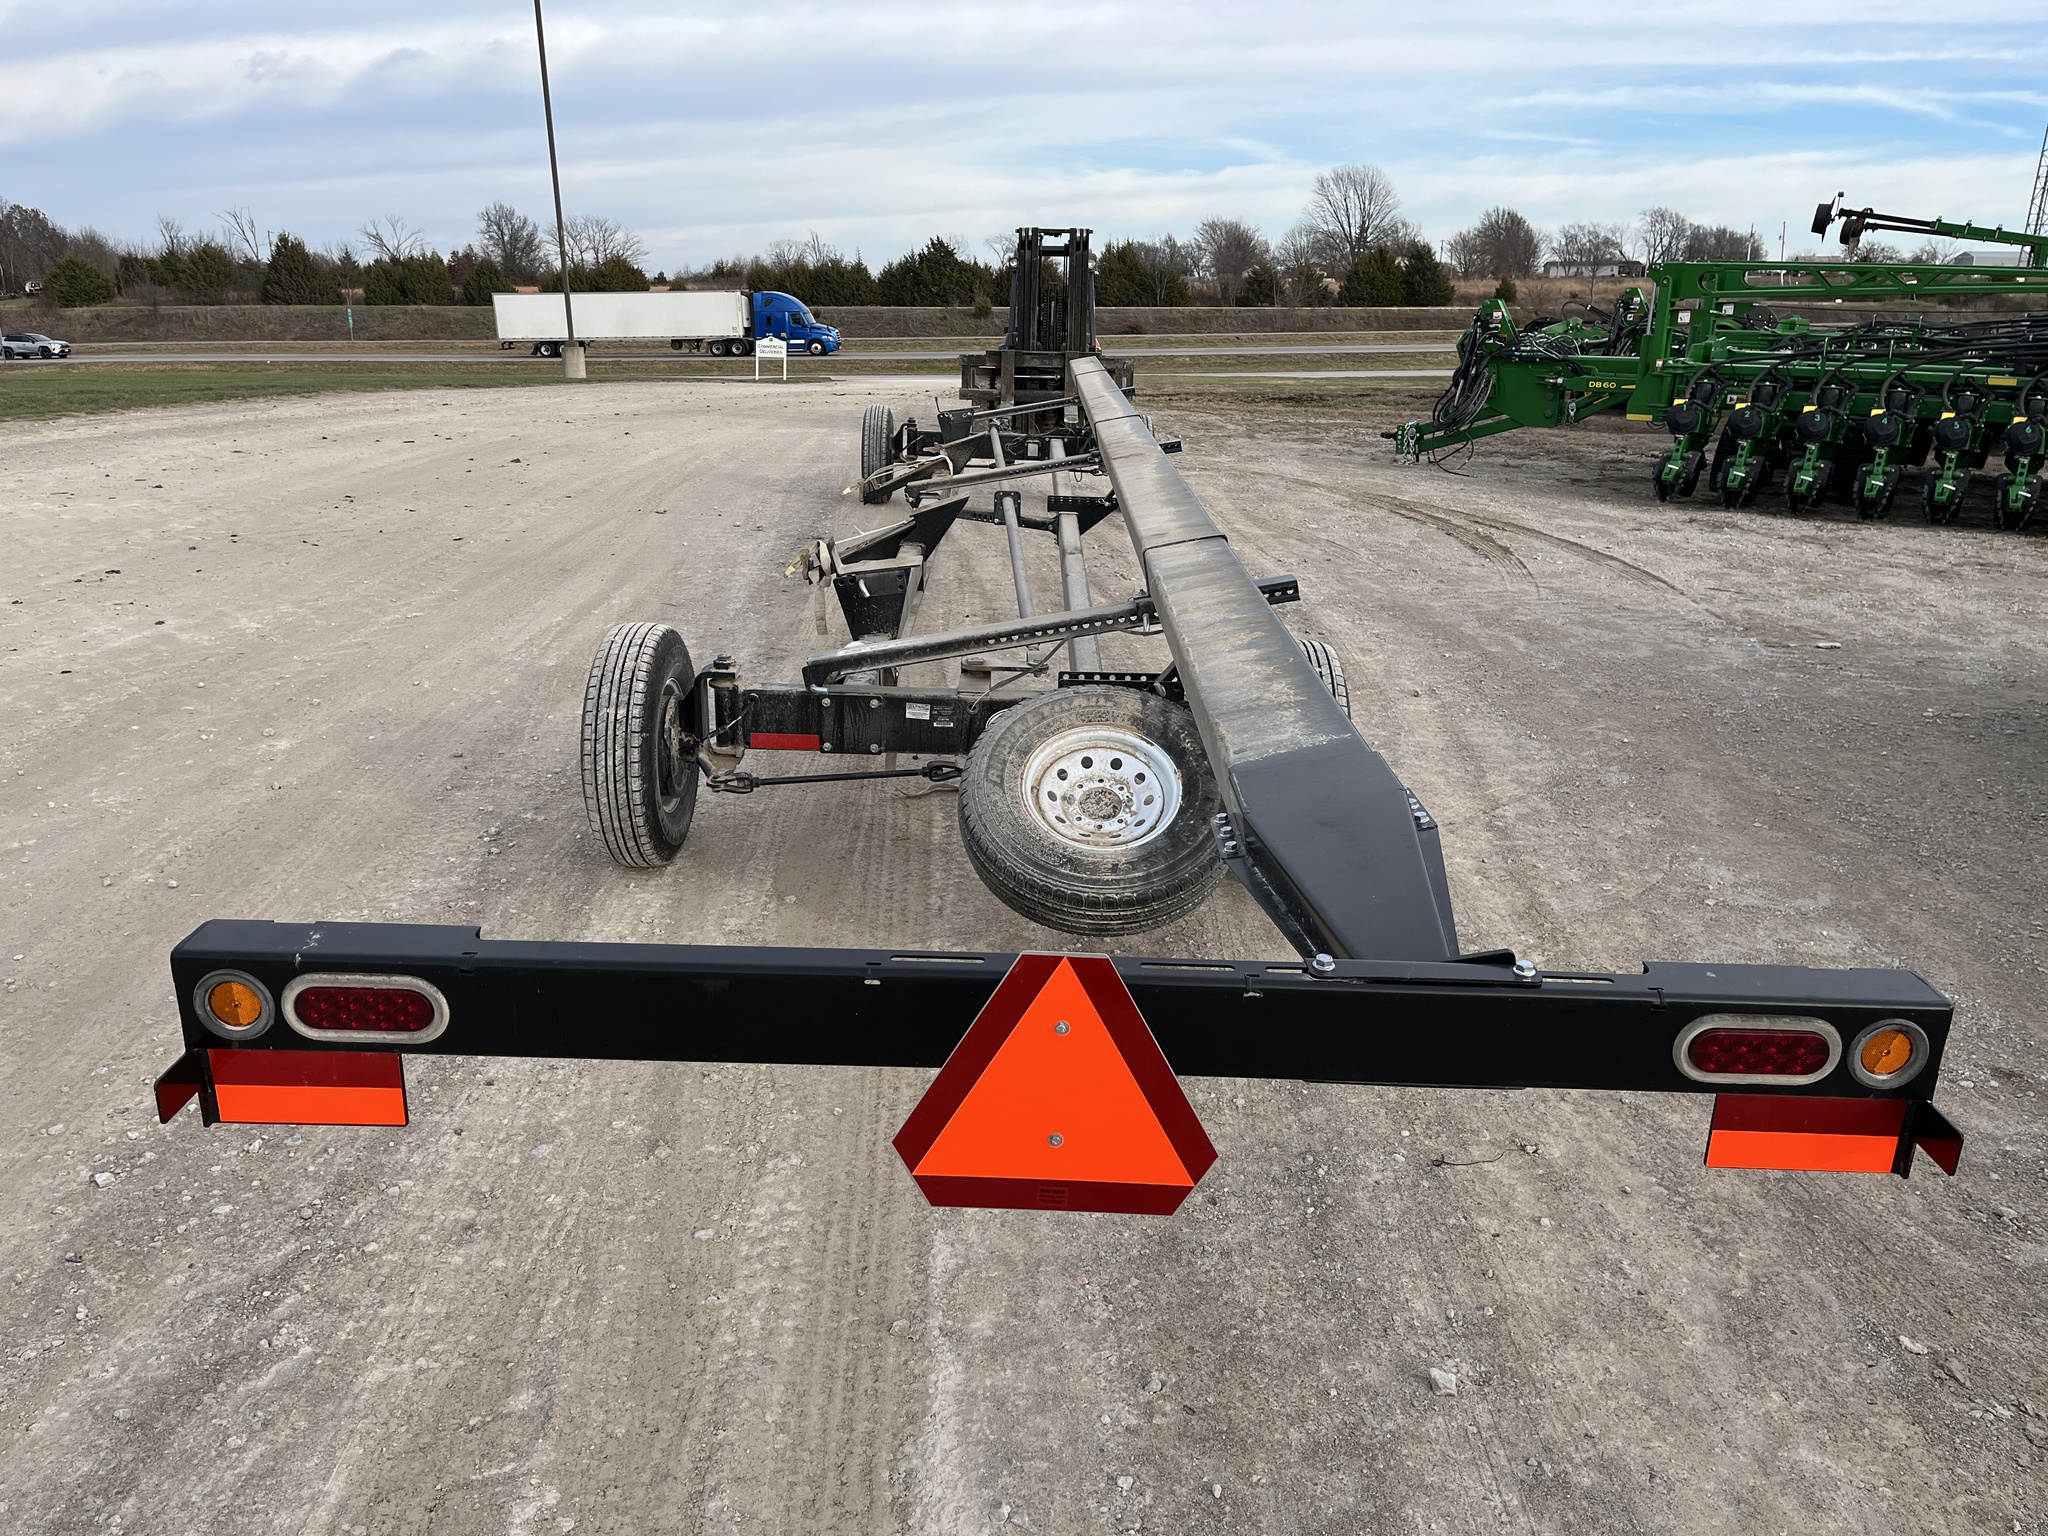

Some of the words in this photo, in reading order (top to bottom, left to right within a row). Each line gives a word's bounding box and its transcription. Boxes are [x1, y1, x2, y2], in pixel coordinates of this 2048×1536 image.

[1588, 381, 1617, 389] DB60
[1814, 414, 1821, 422] 3
[1881, 417, 1888, 425] 4
[1954, 421, 1960, 429] 5
